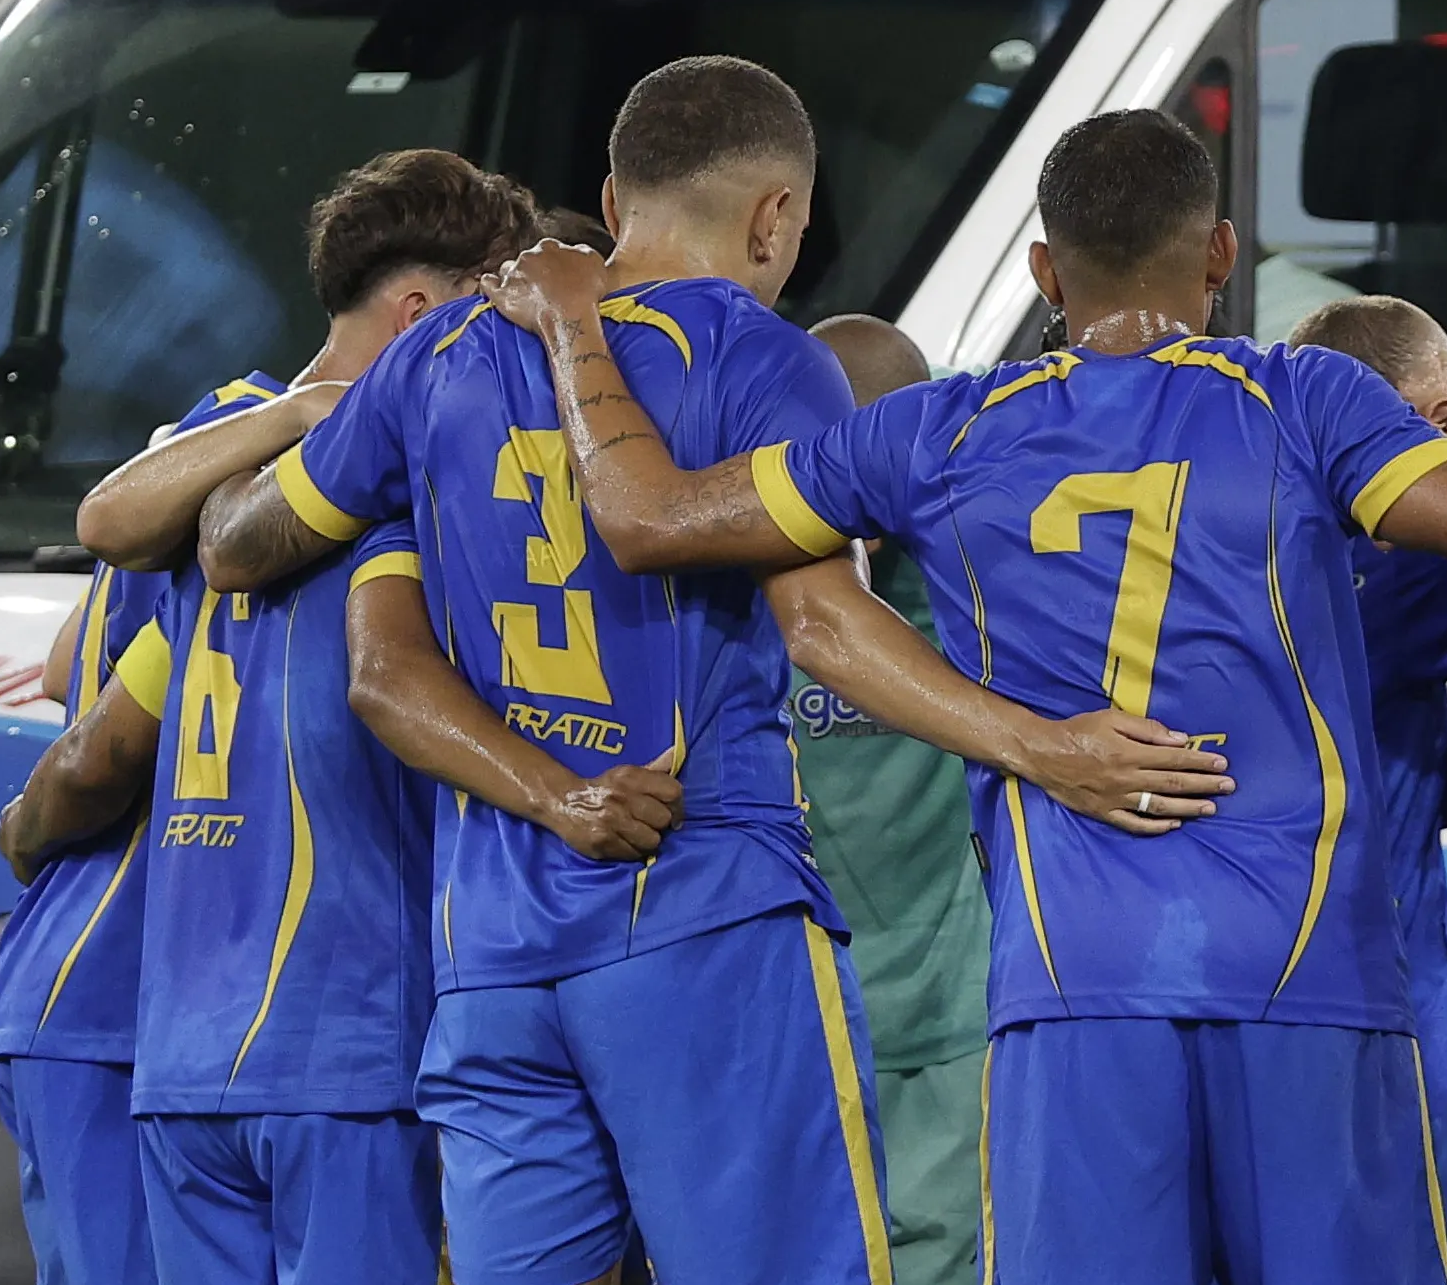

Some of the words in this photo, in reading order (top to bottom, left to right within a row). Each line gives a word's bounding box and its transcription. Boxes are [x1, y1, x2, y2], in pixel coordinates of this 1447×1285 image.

[492, 425, 614, 707] 3
[1030, 460, 1191, 718] 7
[505, 702, 627, 756] PRATIC
